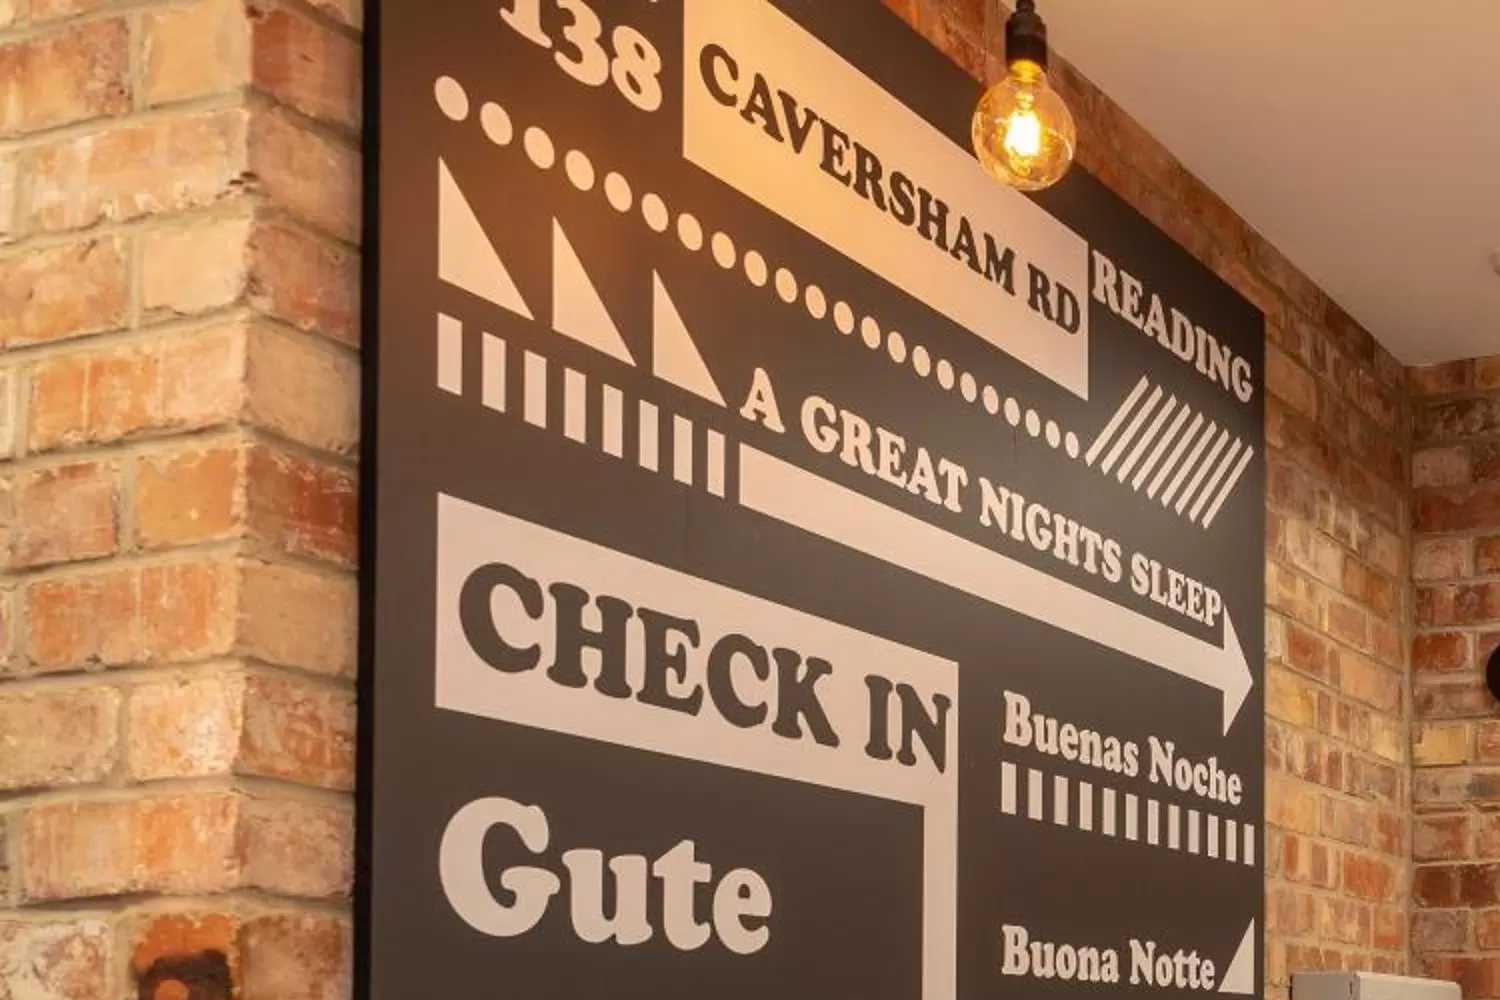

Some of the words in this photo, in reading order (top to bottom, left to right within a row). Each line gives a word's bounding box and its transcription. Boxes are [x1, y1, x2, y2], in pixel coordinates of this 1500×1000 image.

[699, 43, 1016, 297] CAVERSHAM
[1027, 262, 1081, 336] RD
[1092, 249, 1254, 403] READING
[739, 367, 786, 434] A
[800, 395, 968, 514] GREAT
[977, 476, 1122, 584] NIGHTS
[1129, 551, 1222, 627] SLEEP
[458, 562, 841, 749] CHECK
[863, 674, 952, 776] IN
[1002, 689, 1139, 778] Buenas
[1147, 735, 1243, 807] Noche
[439, 796, 773, 955] Gute
[1001, 923, 1120, 984] Buona
[1129, 938, 1216, 992] Notte
